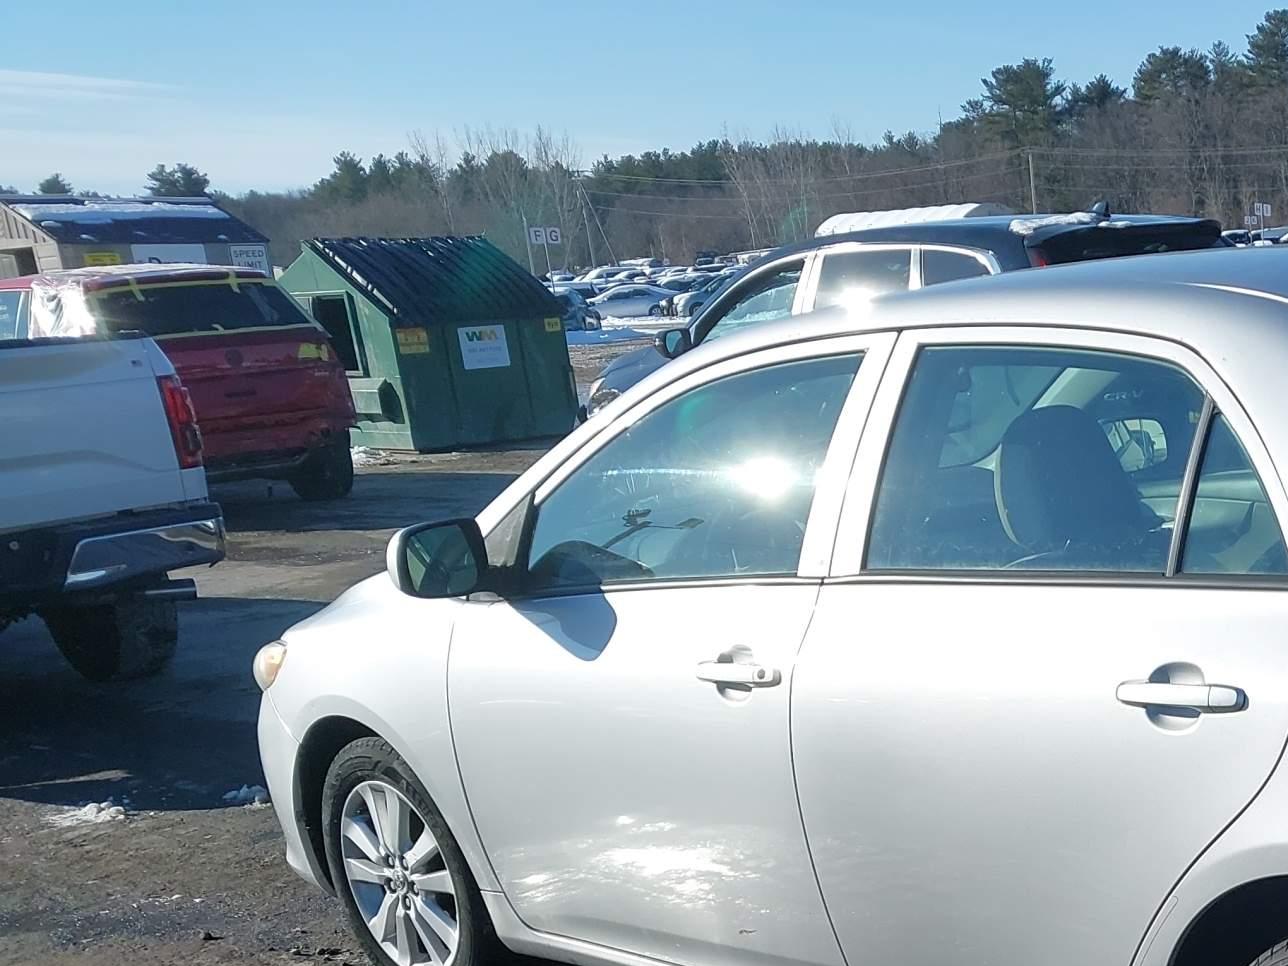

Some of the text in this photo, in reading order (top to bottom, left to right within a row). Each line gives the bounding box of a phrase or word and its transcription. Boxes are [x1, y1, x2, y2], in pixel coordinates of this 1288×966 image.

[533, 230, 541, 242] F
[549, 230, 559, 242] G
[232, 249, 264, 258] SPEED
